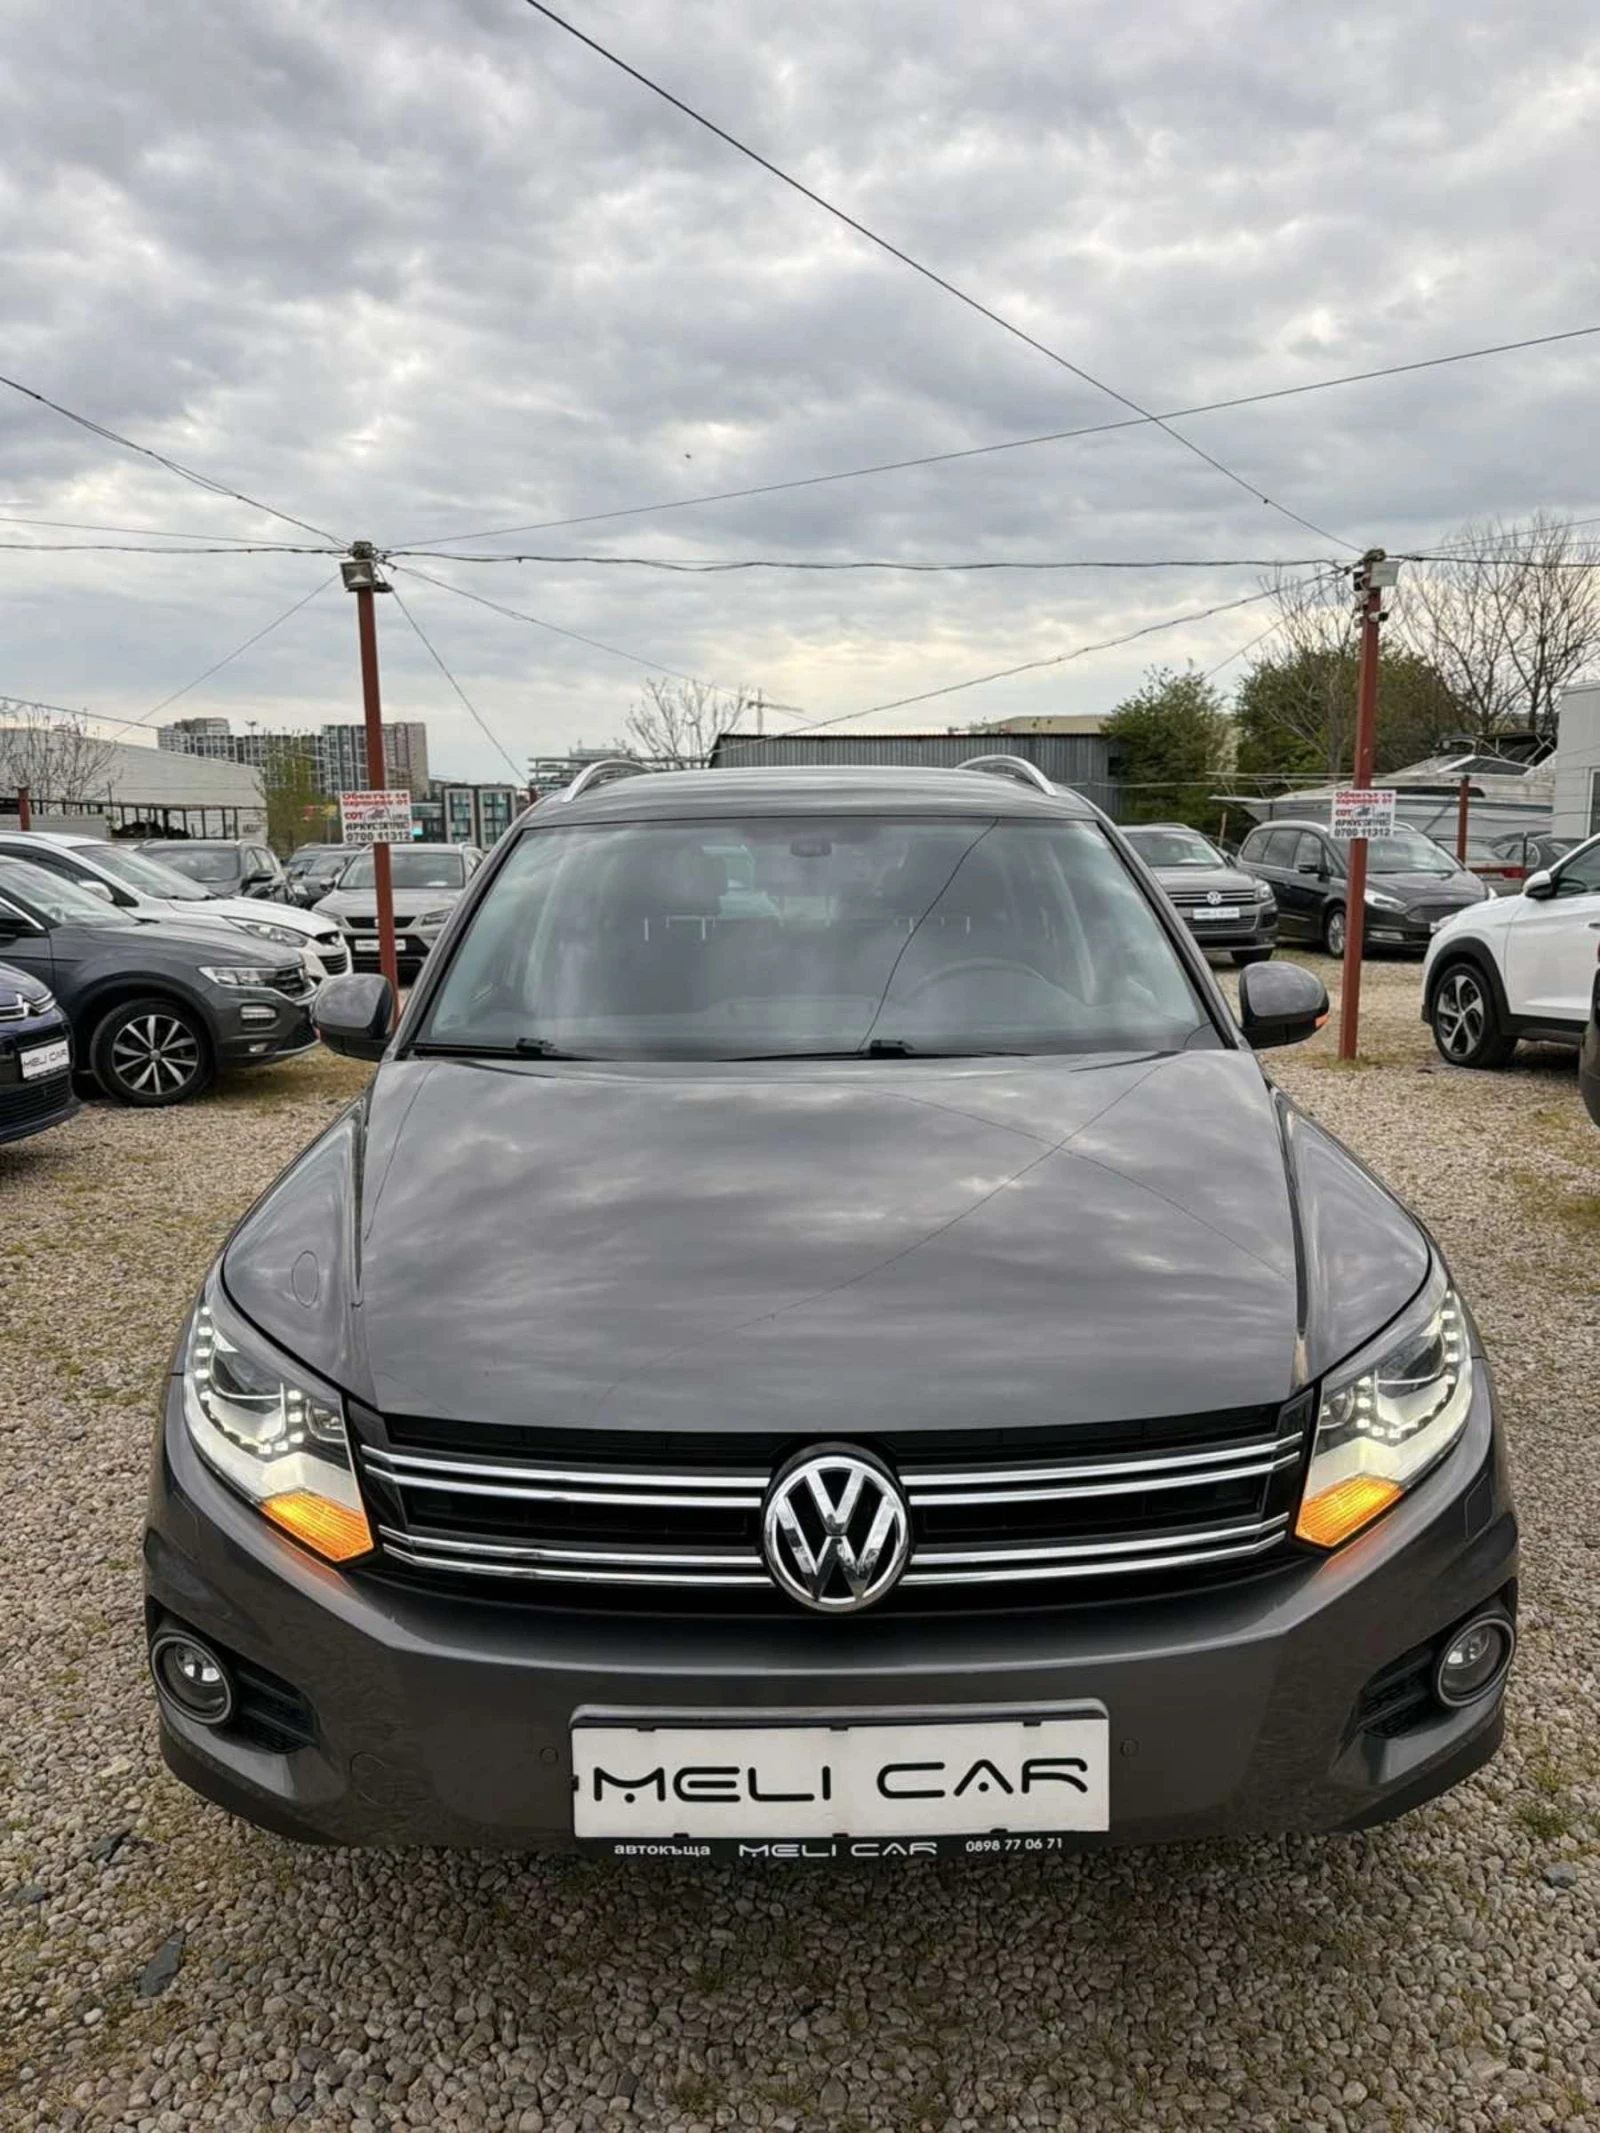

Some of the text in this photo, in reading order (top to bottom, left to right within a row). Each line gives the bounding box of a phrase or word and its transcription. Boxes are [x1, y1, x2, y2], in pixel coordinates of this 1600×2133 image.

[345, 831, 411, 841] 0700 11312
[1334, 828, 1391, 837] 0700 11312
[593, 1759, 1089, 1804] MELI CAR
[614, 1843, 711, 1857] автокъща
[738, 1842, 937, 1858] MELI CAR
[965, 1837, 1063, 1853] 0898 77 06 71
